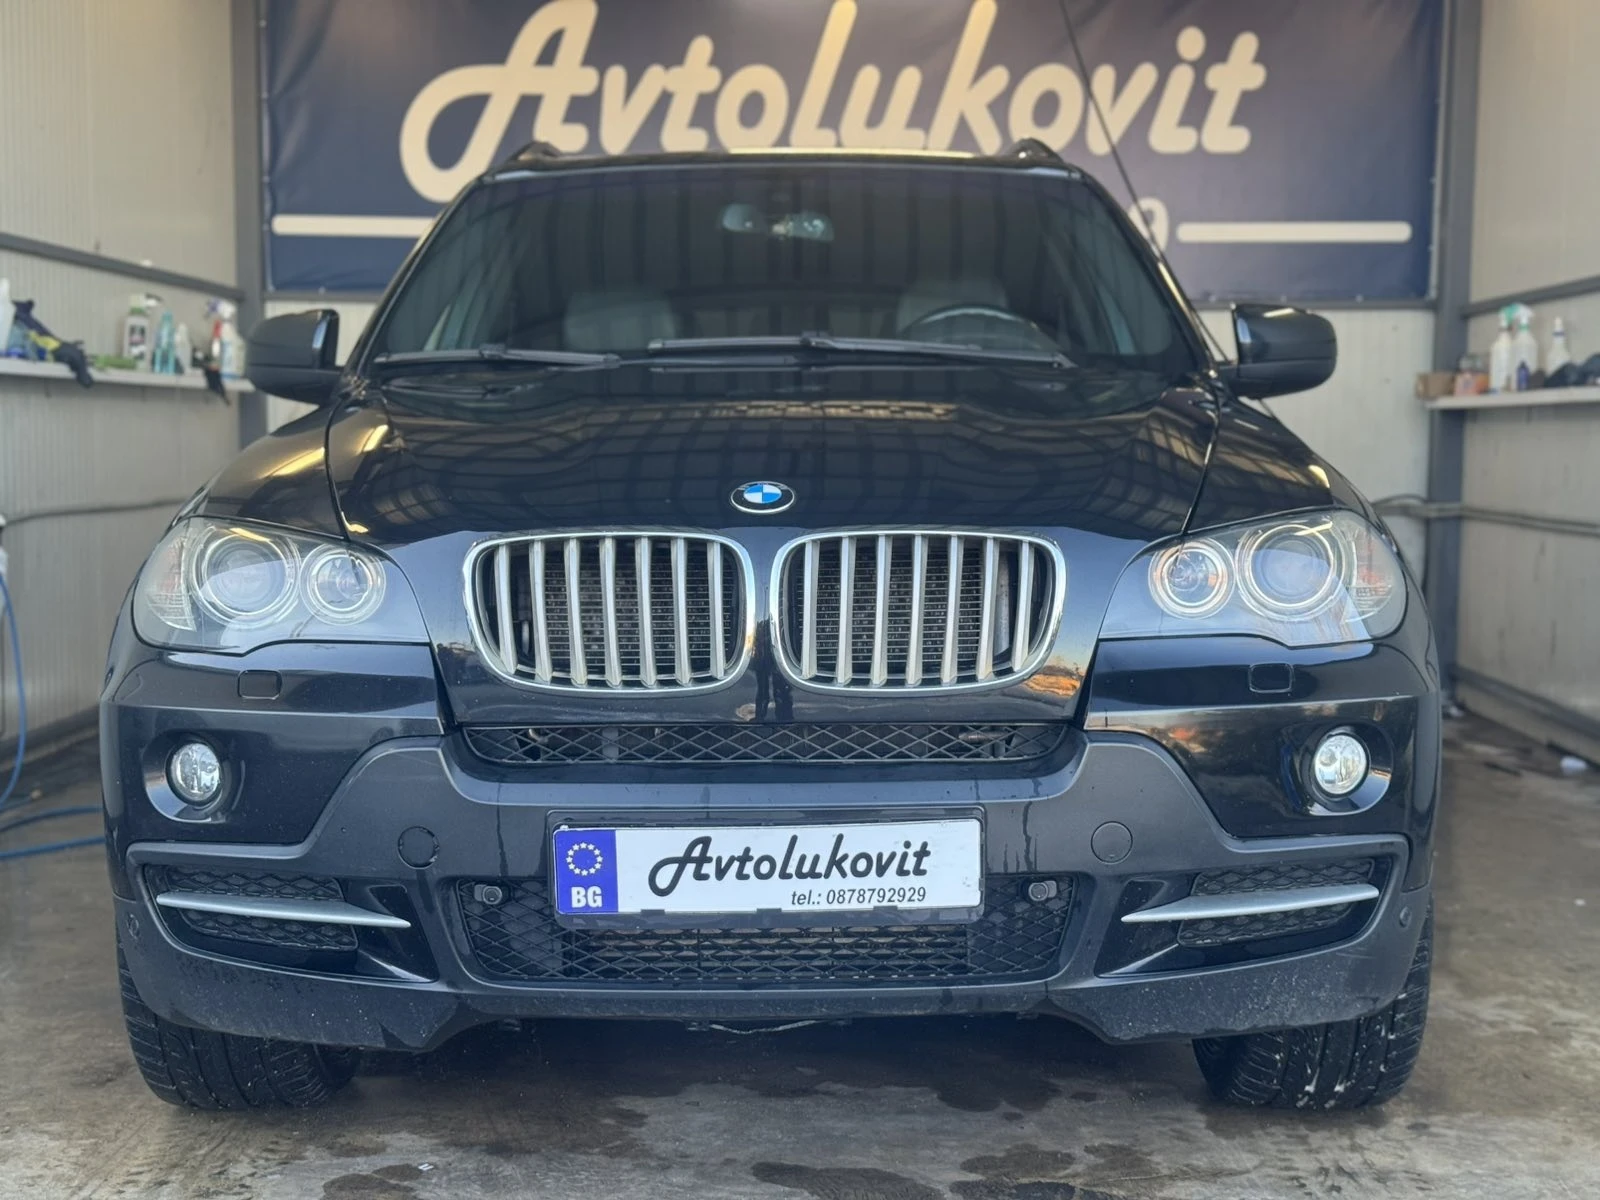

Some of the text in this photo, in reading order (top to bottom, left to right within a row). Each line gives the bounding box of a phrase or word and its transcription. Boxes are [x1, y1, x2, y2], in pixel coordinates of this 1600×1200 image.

[400, 0, 1266, 202] Avtolukovit
[648, 833, 931, 896] Avtolukovit
[571, 886, 602, 908] BG
[791, 887, 927, 906] tel.: 0878792929
